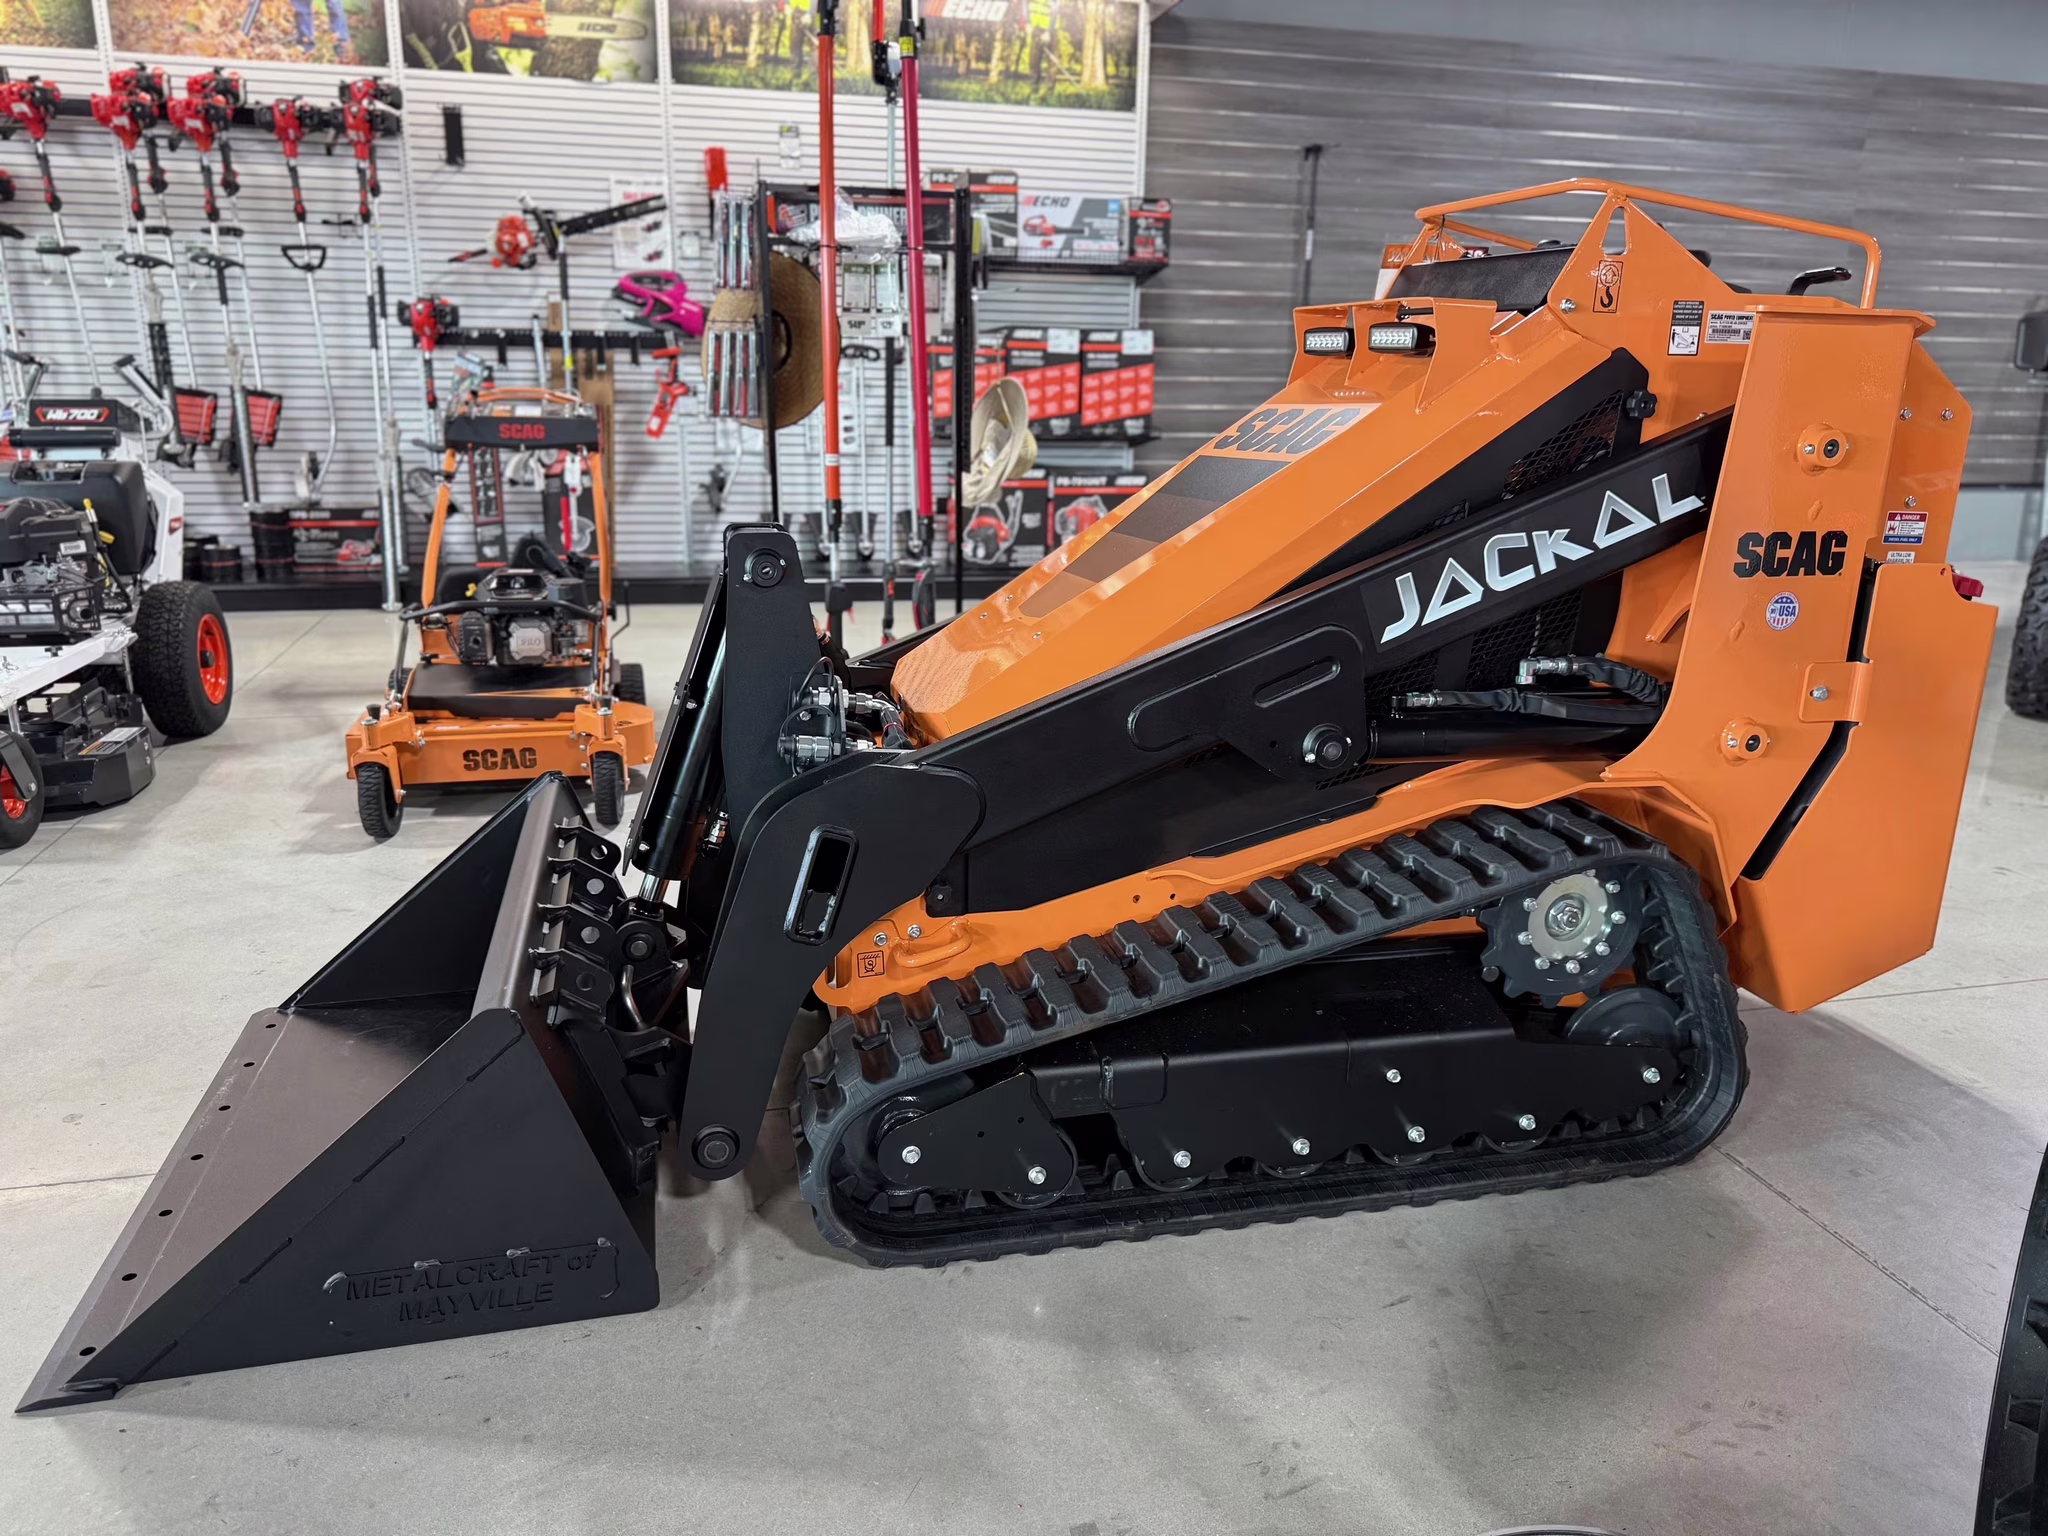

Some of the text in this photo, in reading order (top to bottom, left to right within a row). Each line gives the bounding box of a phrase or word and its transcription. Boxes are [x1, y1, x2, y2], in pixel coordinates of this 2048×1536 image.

[942, 0, 1009, 21] ECHO
[1034, 196, 1071, 208] ECHO
[499, 424, 546, 440] SCAG
[1213, 408, 1361, 455] SCAG
[1380, 473, 1704, 644] JACKAL
[1733, 530, 1849, 578] SCAG
[1778, 605, 1797, 618] USA
[463, 747, 538, 772] SCAG
[346, 1255, 561, 1301] METALCRAFT
[399, 1283, 555, 1323] MAYVILLE
